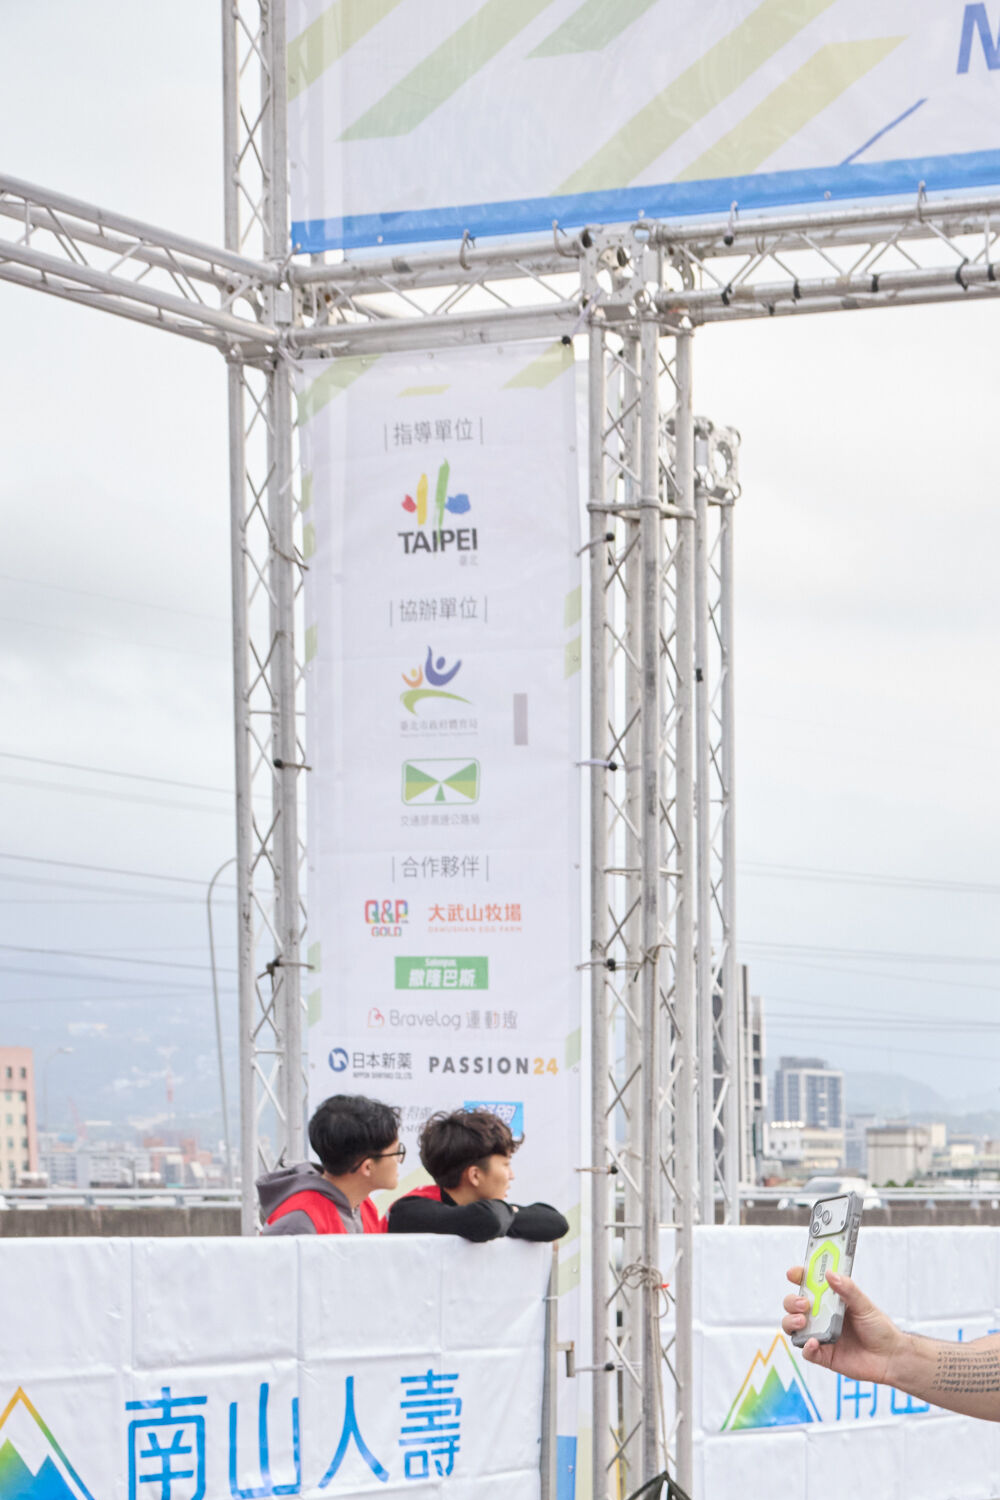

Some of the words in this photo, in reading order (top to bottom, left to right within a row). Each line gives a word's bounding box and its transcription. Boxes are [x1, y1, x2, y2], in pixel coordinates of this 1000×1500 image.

[393, 418, 474, 446] 指導單位
[397, 527, 478, 554] TAIPEI
[399, 597, 479, 623] 協辦單位
[400, 856, 480, 879] 合作夥伴
[365, 899, 409, 924] Q&P
[428, 903, 522, 922] 大武山牧場
[371, 926, 402, 938] GOLD
